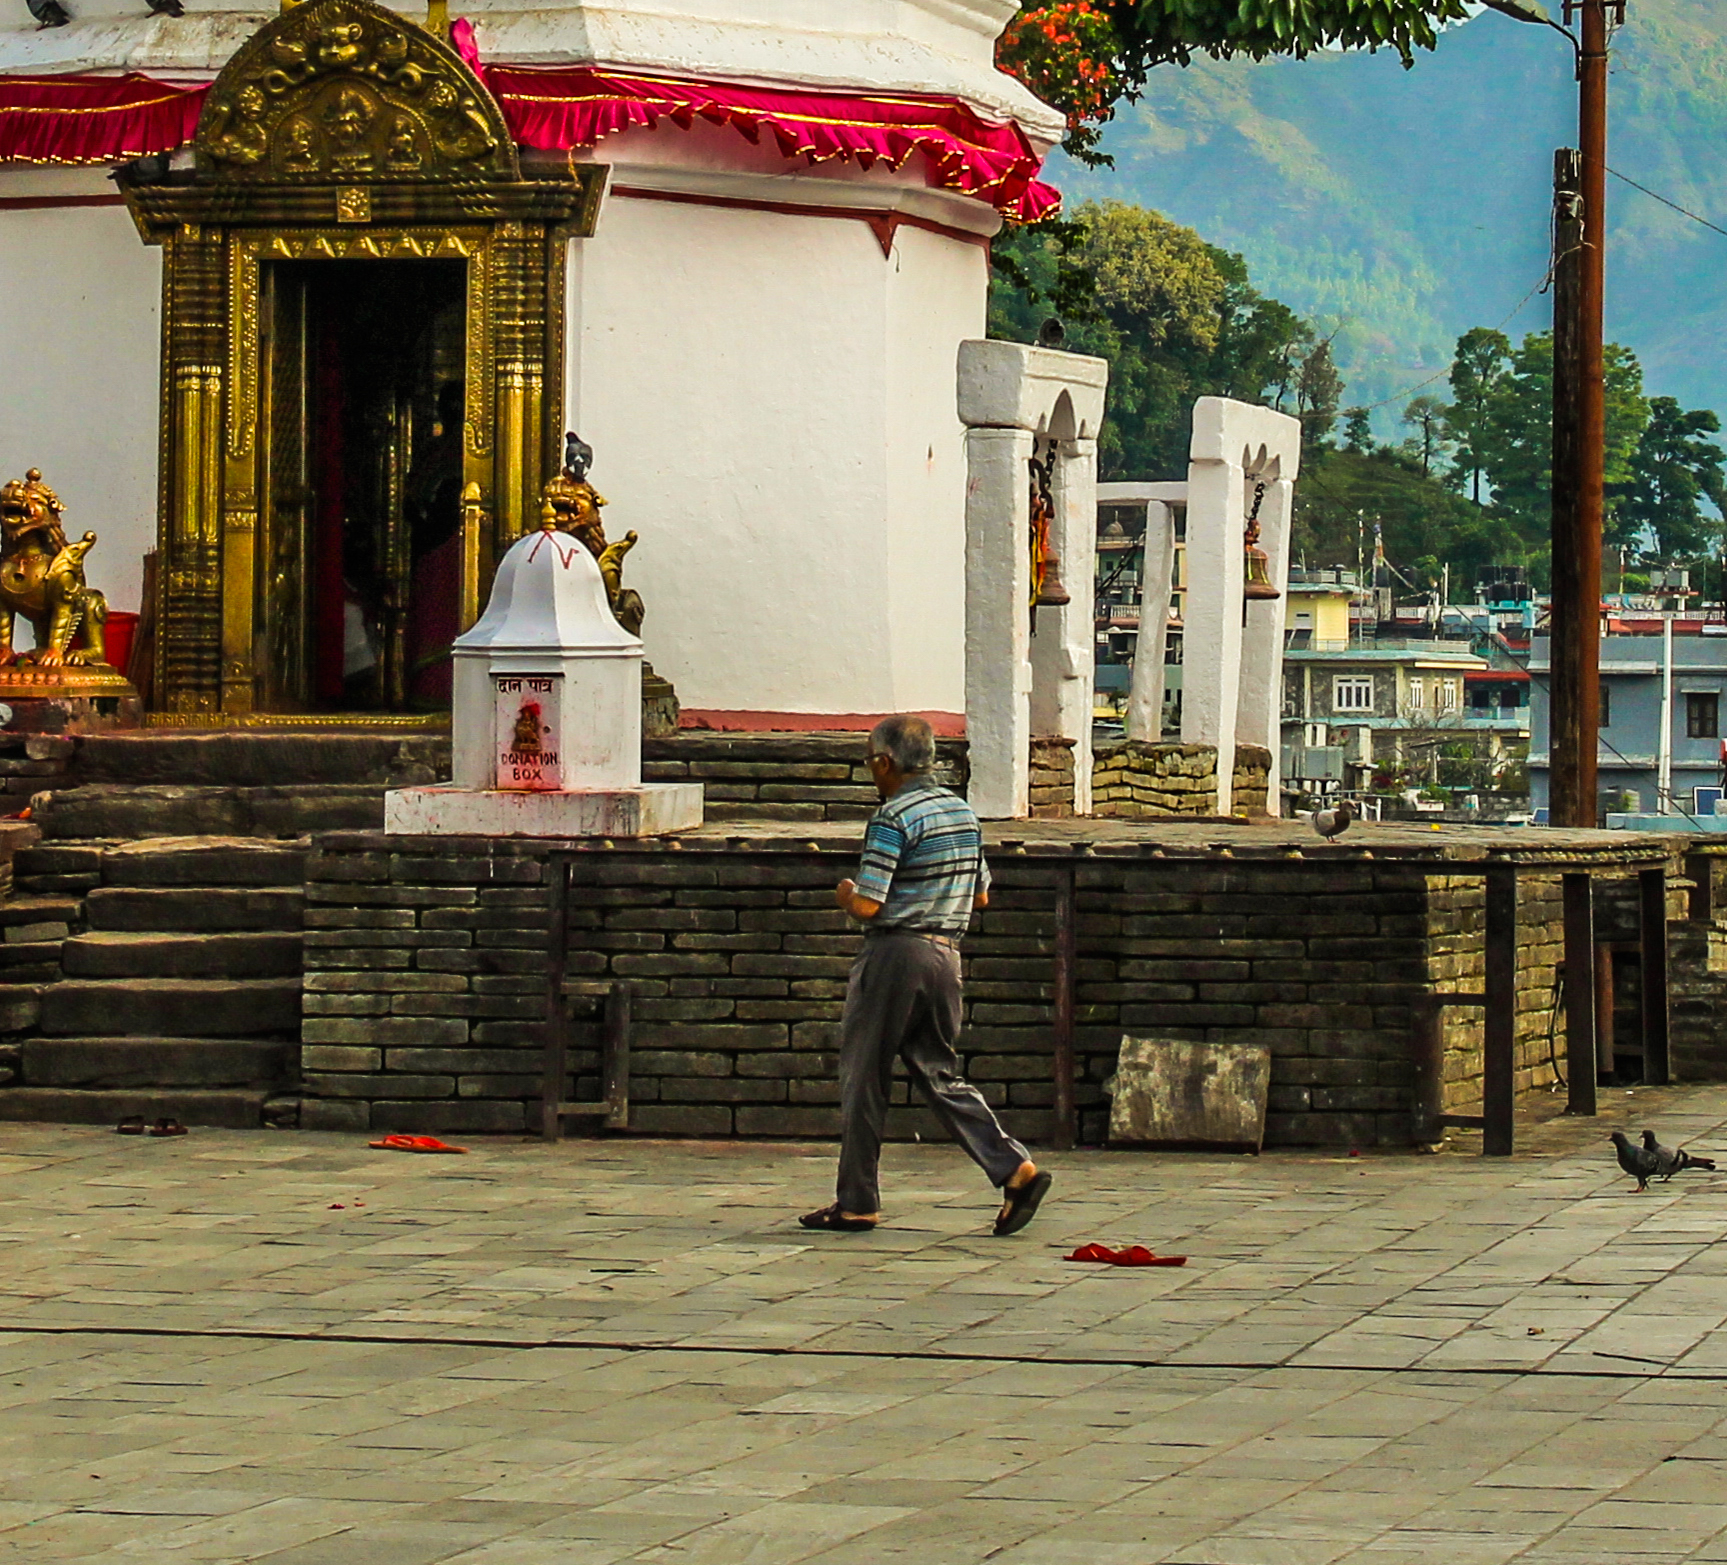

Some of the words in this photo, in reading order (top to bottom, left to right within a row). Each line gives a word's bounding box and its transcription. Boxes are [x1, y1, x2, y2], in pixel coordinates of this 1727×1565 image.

[498, 679, 522, 695] दान
[527, 679, 553, 693] पात्र
[501, 752, 558, 766] DONATION
[513, 768, 543, 780] BOX
